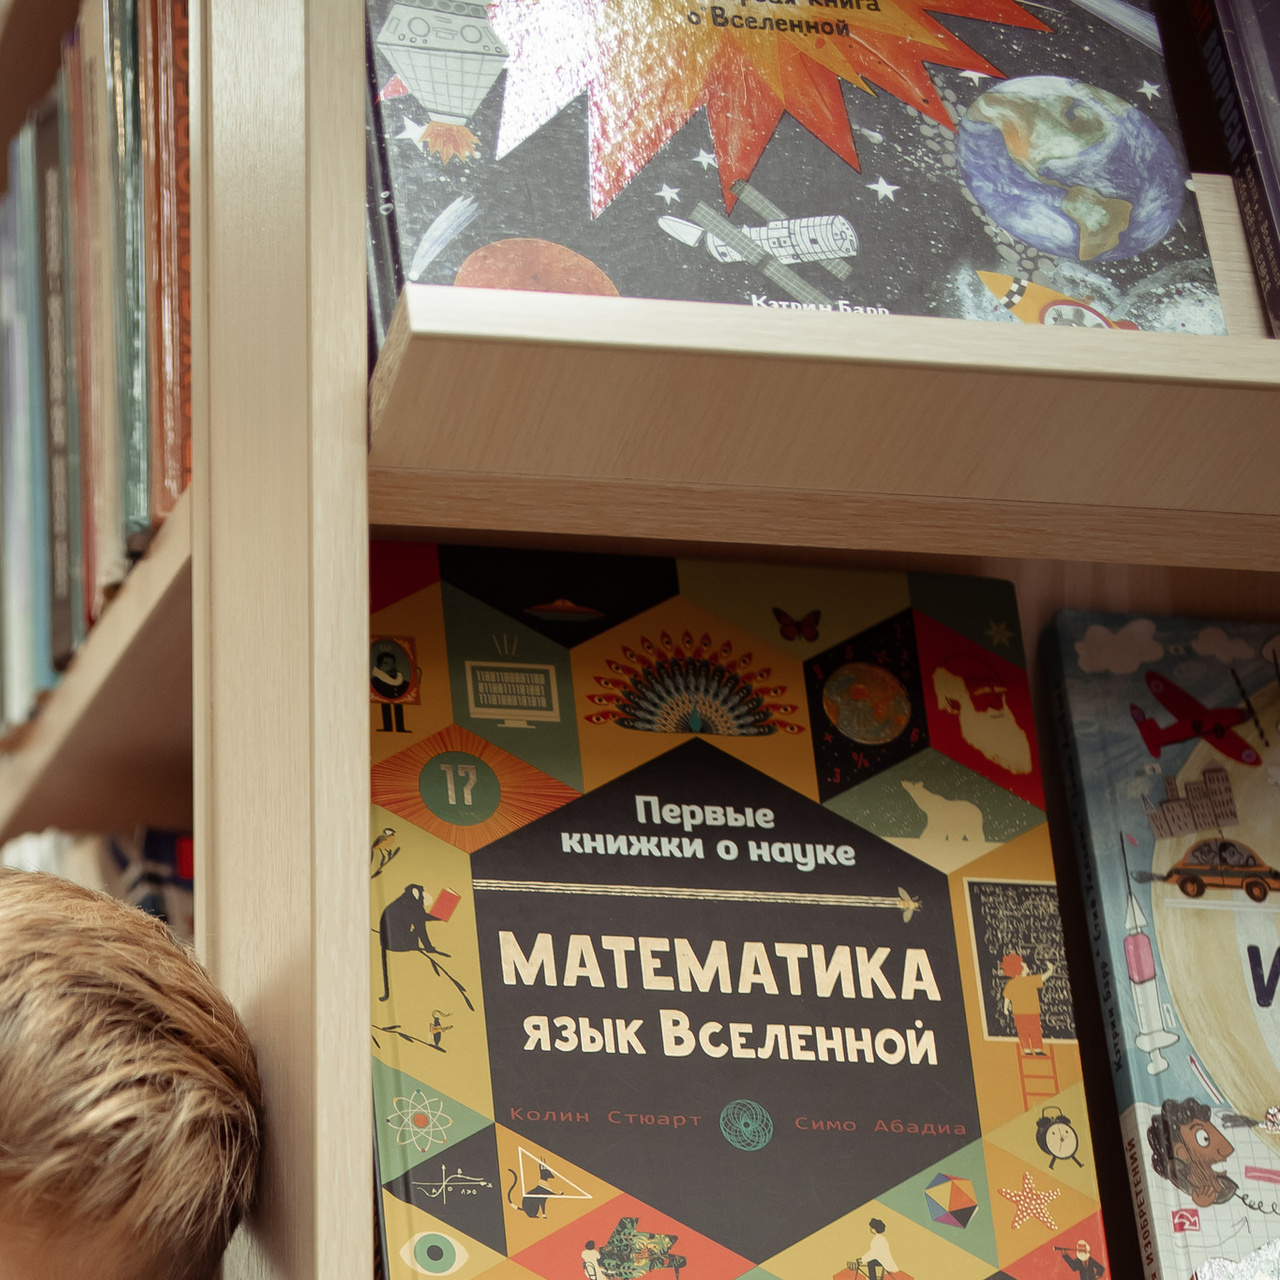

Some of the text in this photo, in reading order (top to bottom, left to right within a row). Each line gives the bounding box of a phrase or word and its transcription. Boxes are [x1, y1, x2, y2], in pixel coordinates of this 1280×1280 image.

[711, 6, 850, 37] Вселенной
[439, 763, 478, 806] 17
[635, 793, 776, 831] Первые
[561, 828, 857, 872] книжки о науке
[498, 931, 941, 1002] МАТЕМАТИКА
[1106, 1008, 1123, 1072] Кэтрин
[509, 1106, 968, 1138] Колин Стюарт Симо Абадиа
[1125, 1137, 1154, 1266] ИЗОБРЕТЕНИЙ
